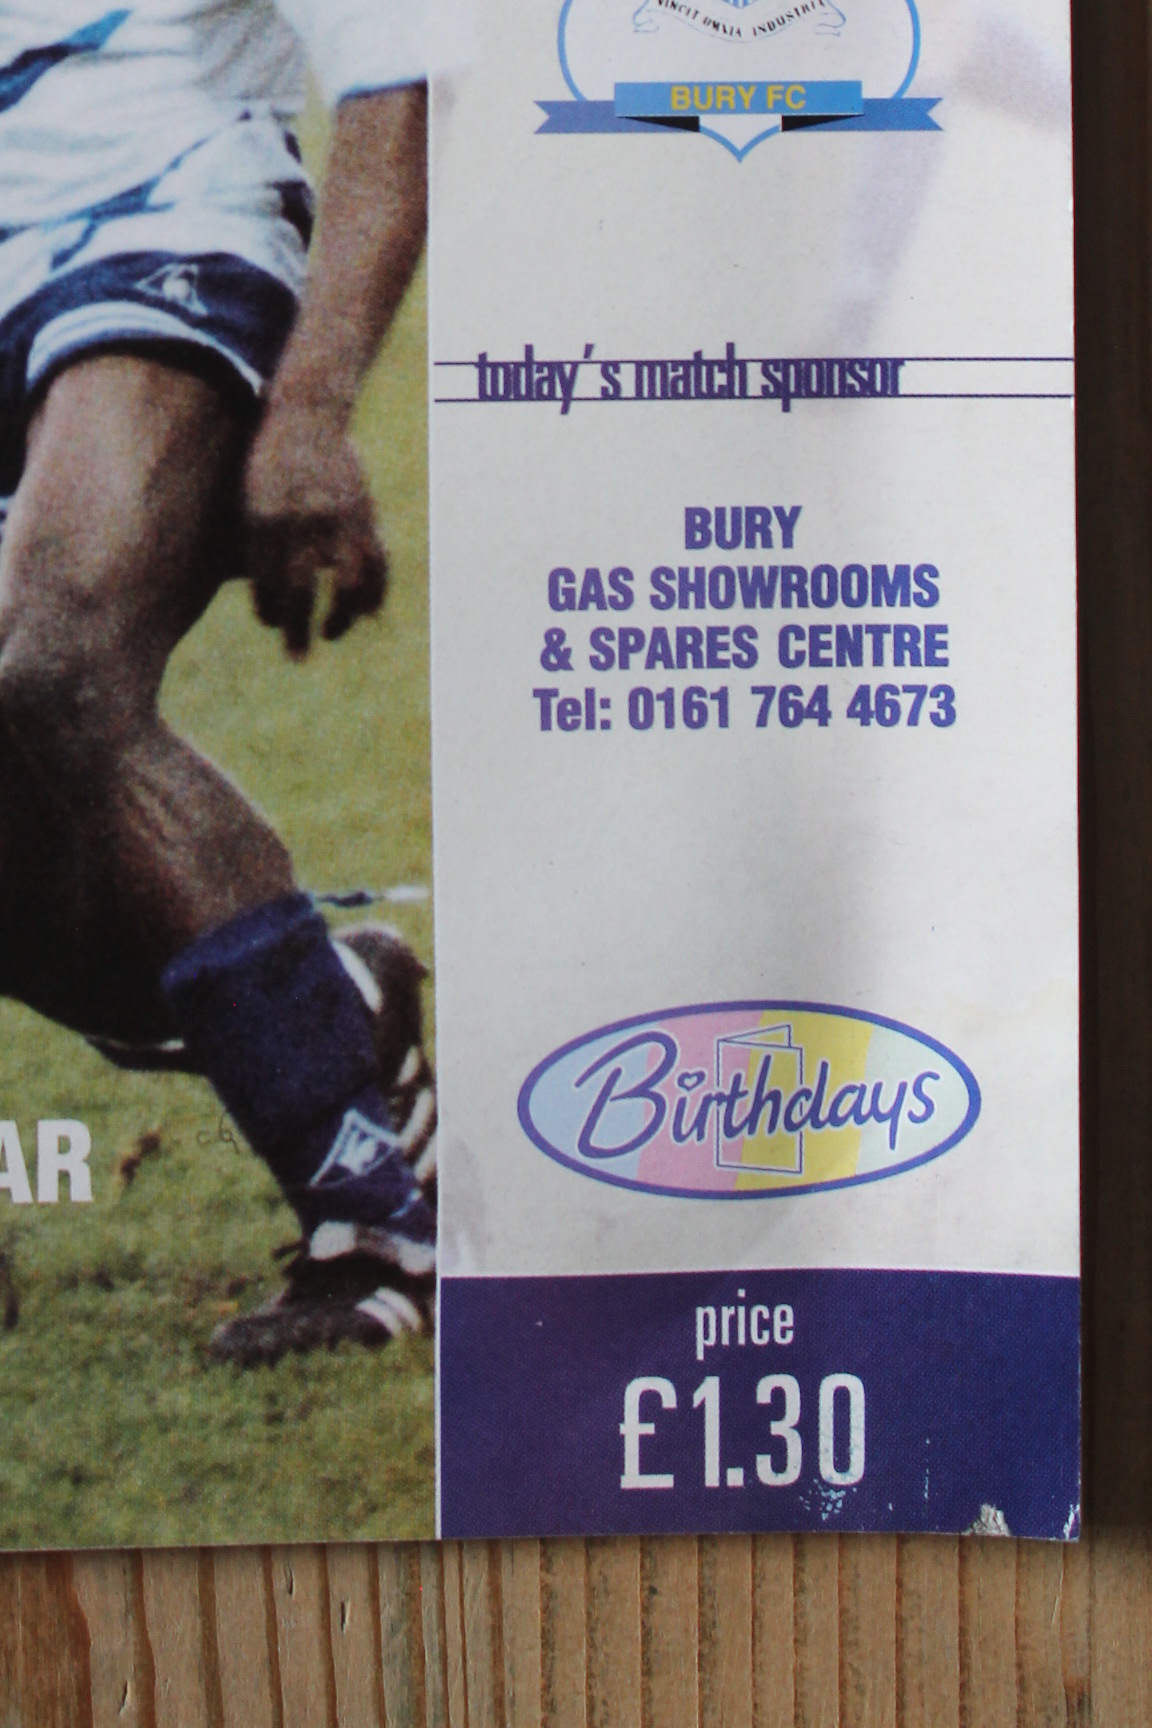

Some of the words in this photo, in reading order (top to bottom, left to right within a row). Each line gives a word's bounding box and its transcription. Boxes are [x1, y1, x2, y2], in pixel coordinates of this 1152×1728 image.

[670, 85, 755, 111] BURY
[766, 84, 807, 110] FC
[635, 342, 748, 399] match
[760, 358, 905, 413] sponsor
[684, 505, 803, 550] BURY
[548, 567, 634, 611] GAS
[649, 564, 940, 610] SHOWROOMS
[540, 627, 573, 672] &
[589, 625, 759, 670] SPARES
[778, 624, 949, 668] CENTRE
[532, 687, 612, 731] Tel:
[628, 686, 729, 730] 0161
[750, 684, 832, 728] 764
[846, 684, 957, 728] 4673
[574, 1030, 941, 1159] Birthdays
[695, 1289, 795, 1360] price
[619, 1373, 866, 1489] £1.30
